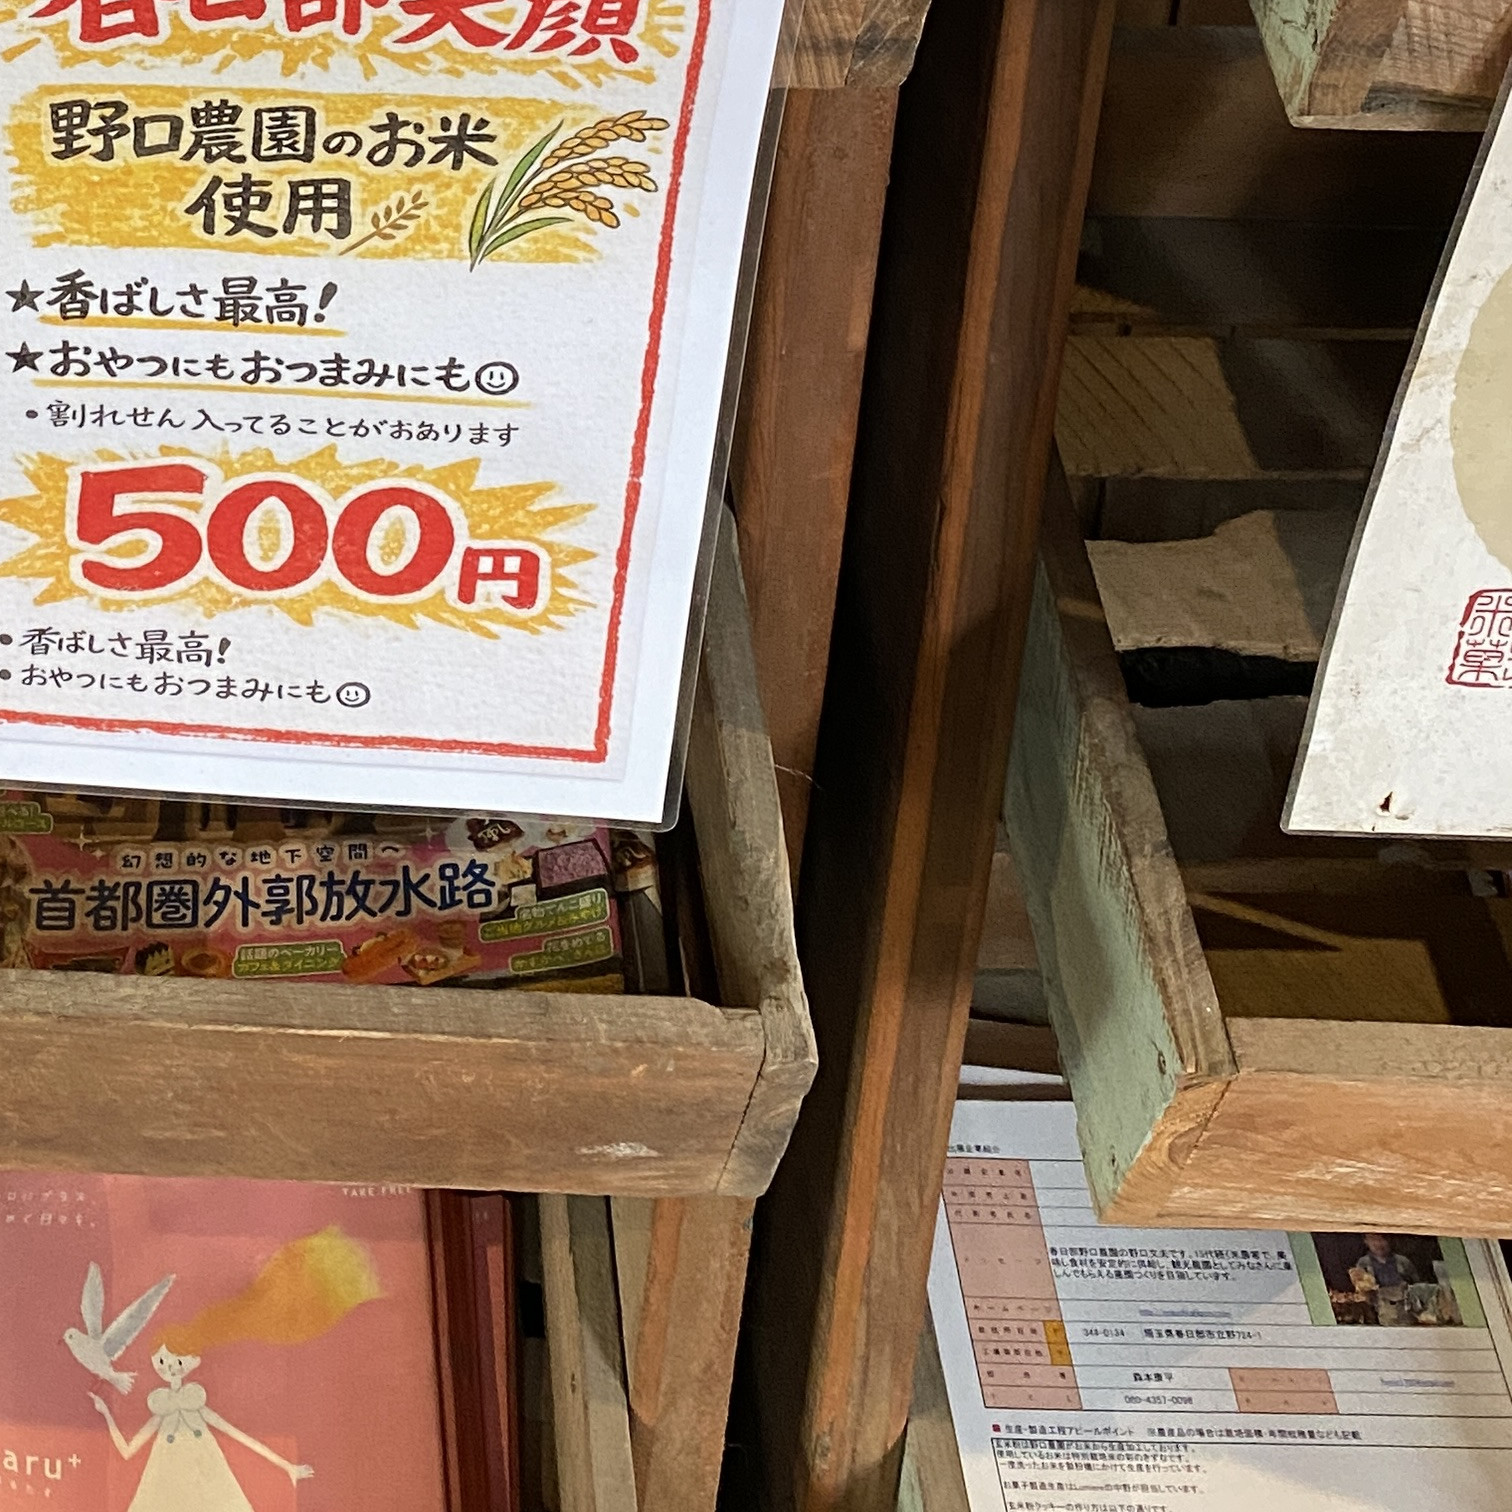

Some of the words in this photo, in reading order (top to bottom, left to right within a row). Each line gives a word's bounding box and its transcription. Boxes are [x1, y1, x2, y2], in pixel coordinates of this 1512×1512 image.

[48, 99, 501, 171] 野口農園のお米
[183, 175, 354, 240] 使用
[76, 461, 543, 611] 500円
[29, 859, 497, 933] 首都圏外郭放水路
